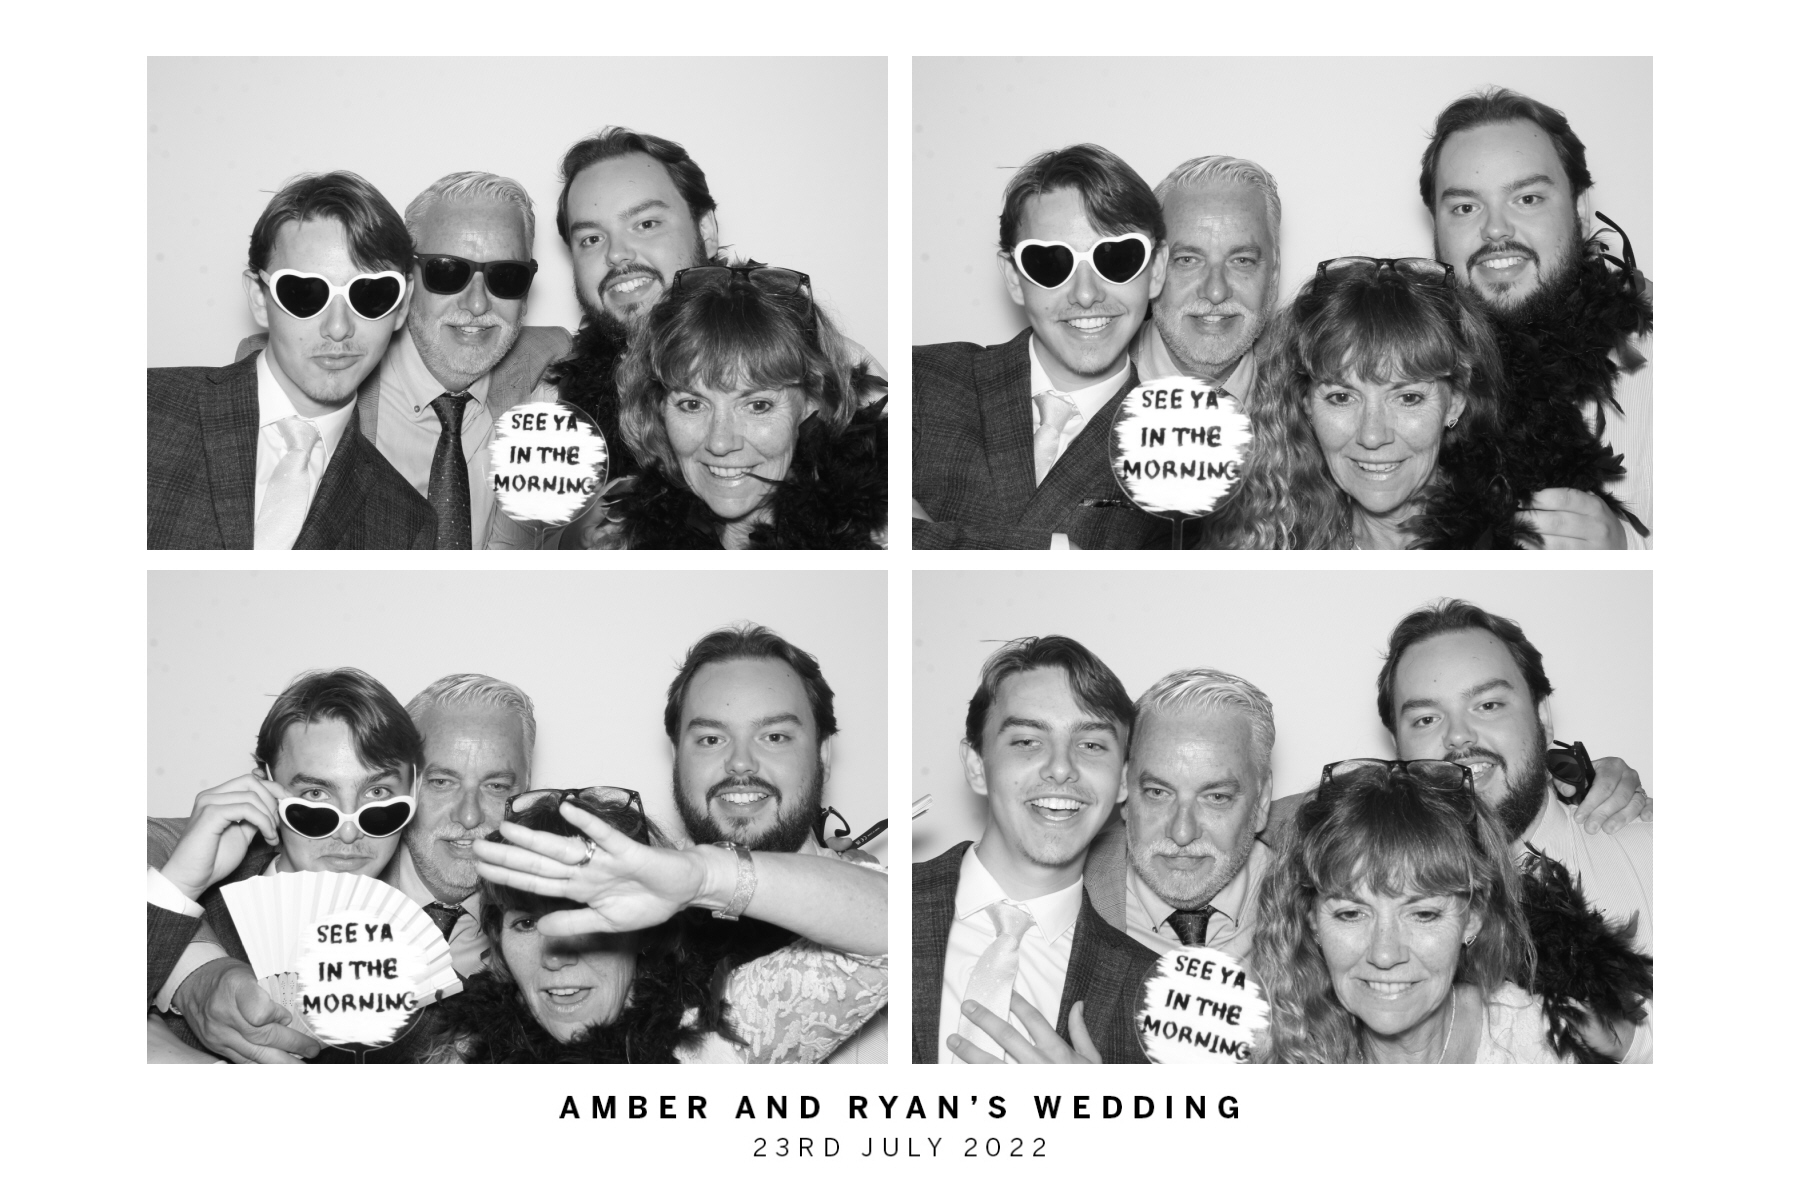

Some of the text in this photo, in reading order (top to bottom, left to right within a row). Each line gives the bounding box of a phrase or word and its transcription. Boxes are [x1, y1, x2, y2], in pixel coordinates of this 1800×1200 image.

[1142, 388, 1219, 410] SEE YA
[511, 412, 578, 432] SEE YA
[1141, 425, 1222, 448] IN THE
[509, 445, 581, 465] IN THE
[1122, 459, 1241, 481] MORNING
[493, 473, 596, 495] MORNING
[317, 922, 394, 944] SEE YA
[318, 957, 399, 982] IN THE
[1174, 955, 1246, 991] SEE YA
[302, 991, 419, 1015] MORNING
[1165, 989, 1243, 1026] IN THE
[1140, 1014, 1251, 1061] MORNING
